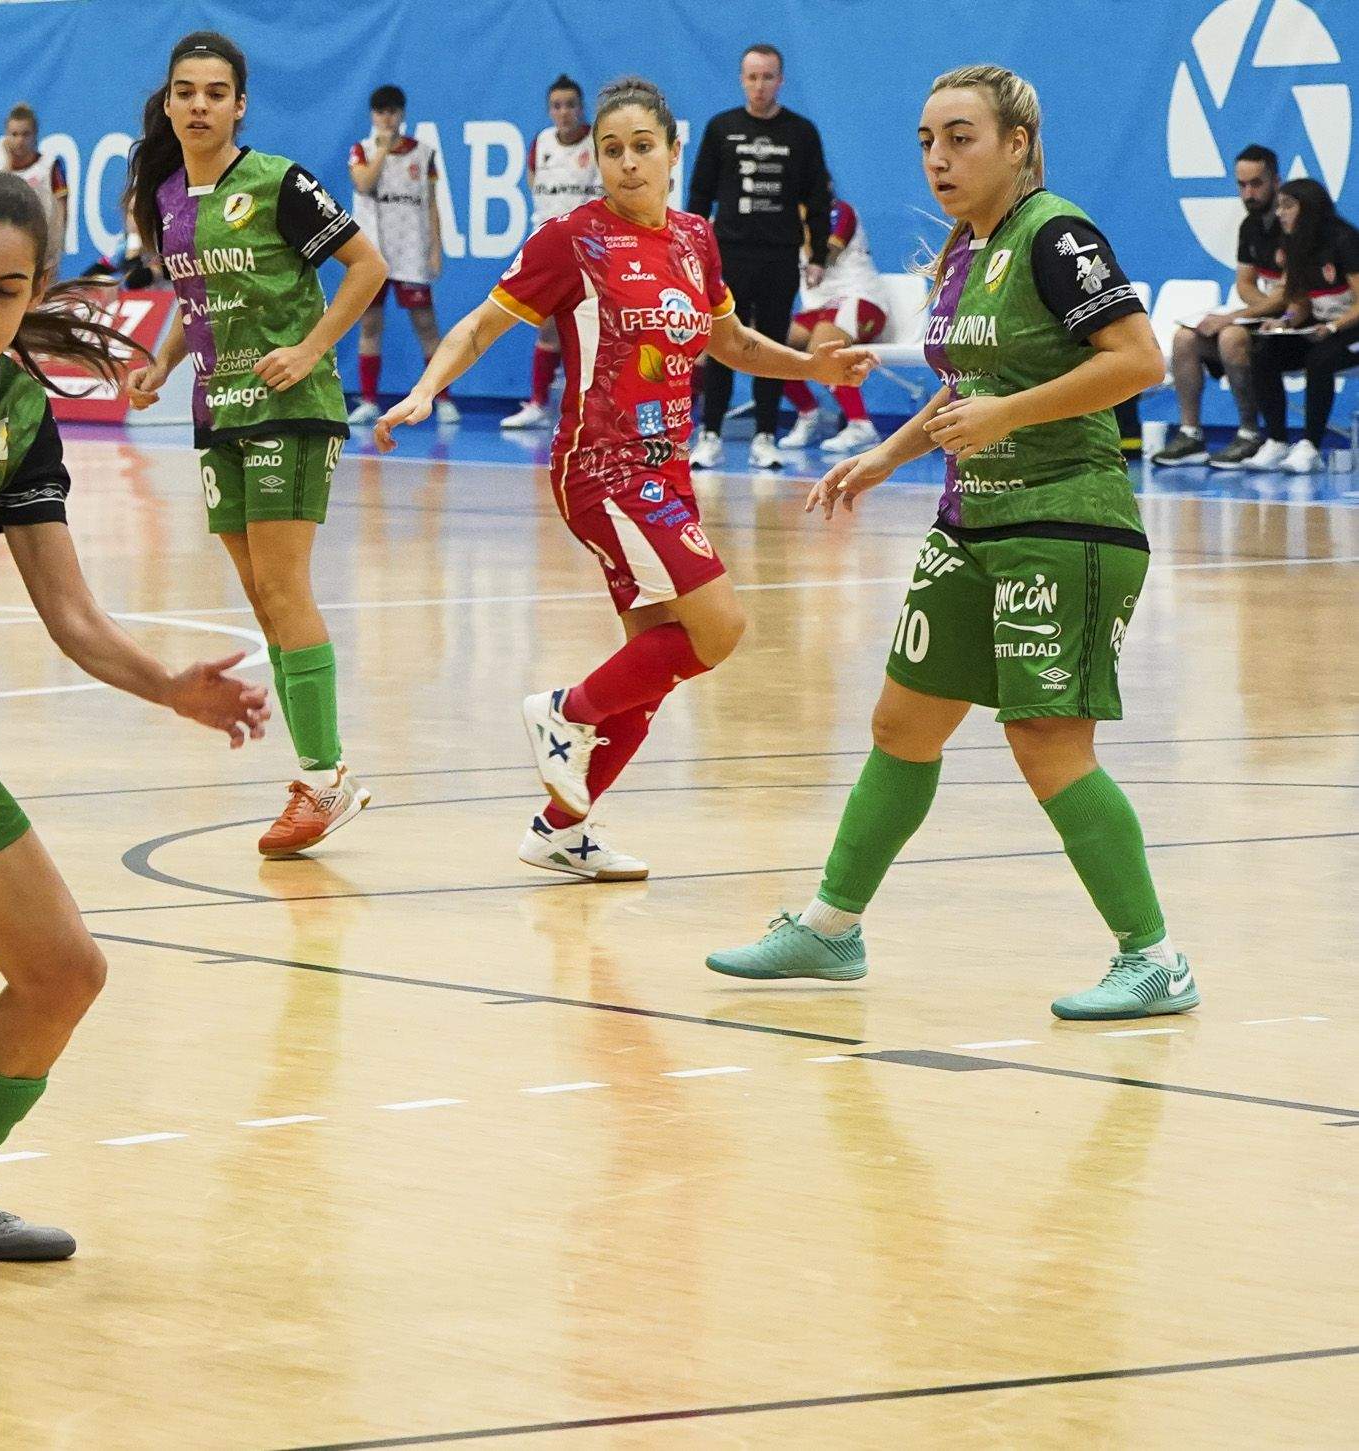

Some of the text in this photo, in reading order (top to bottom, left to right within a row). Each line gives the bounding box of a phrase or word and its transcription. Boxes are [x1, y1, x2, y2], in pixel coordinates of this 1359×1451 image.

[164, 252, 194, 280] ECES
[203, 248, 256, 273] RONDA
[214, 358, 258, 373] COMPIT
[202, 465, 222, 509] 8
[894, 603, 930, 663] 10
